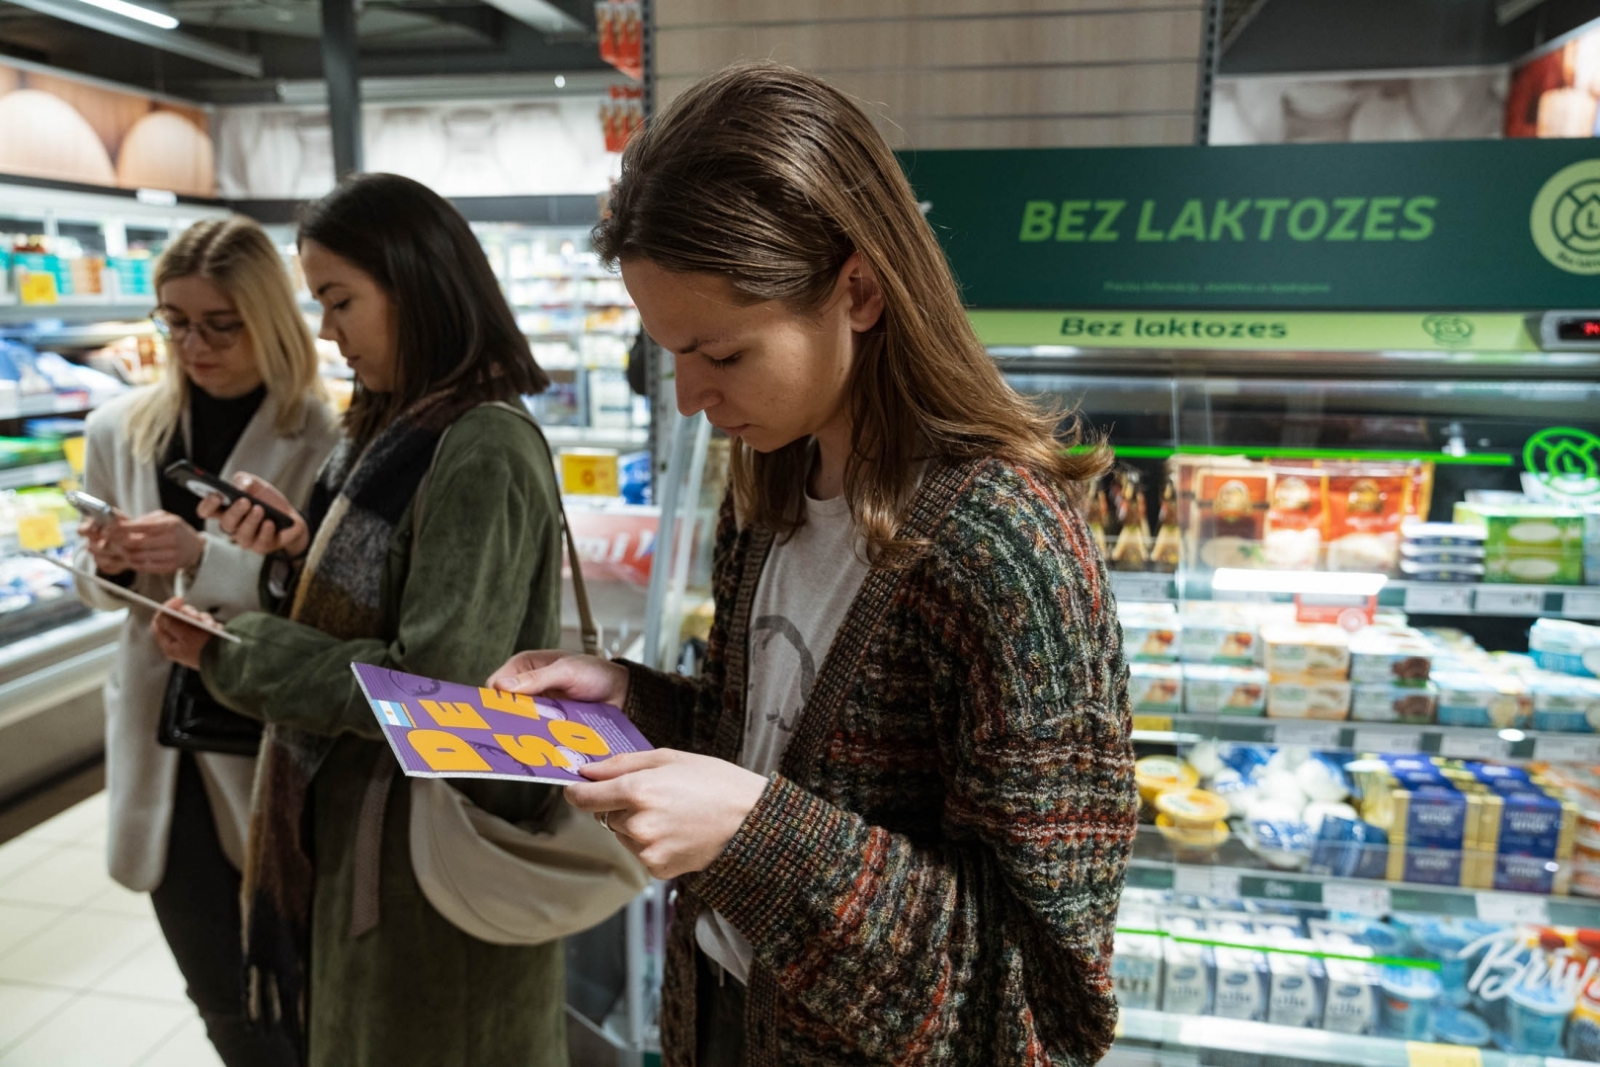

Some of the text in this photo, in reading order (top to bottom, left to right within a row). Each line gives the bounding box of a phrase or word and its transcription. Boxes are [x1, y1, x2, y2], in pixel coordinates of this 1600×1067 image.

[1019, 197, 1438, 242] BEZ LAKTOZES
[1059, 316, 1289, 339] Bez laktozes
